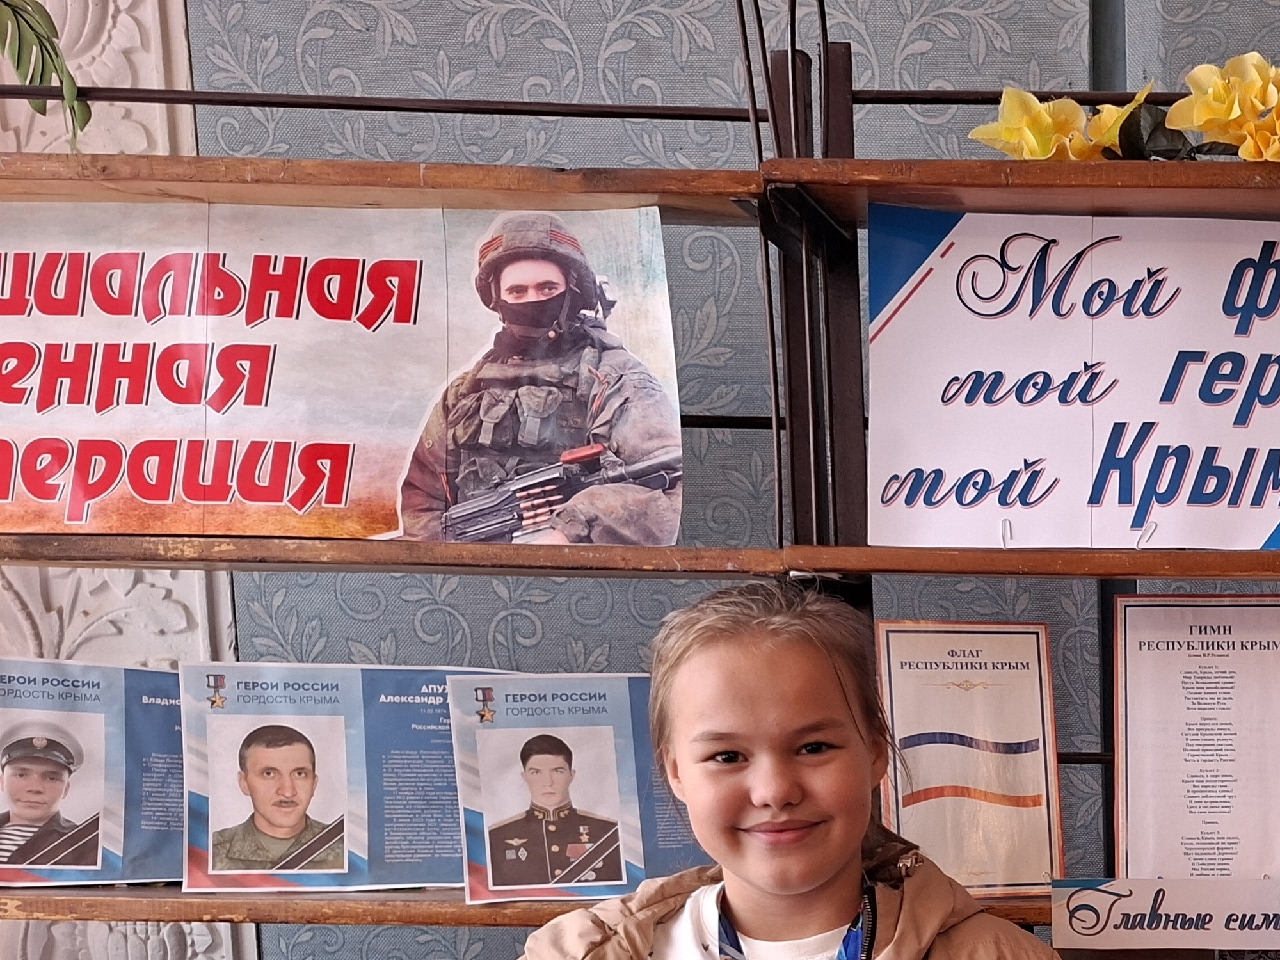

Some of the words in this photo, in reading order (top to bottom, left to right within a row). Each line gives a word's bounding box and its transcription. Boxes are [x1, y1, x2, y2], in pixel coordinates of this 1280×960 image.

[955, 232, 1181, 319] Мой
[941, 361, 1120, 406] мой
[881, 458, 1059, 508] мой
[1189, 625, 1232, 635] ГИМН
[1138, 640, 1236, 652] РЕСПУБЛИКИ
[947, 648, 983, 660] ФЛАГ
[900, 660, 989, 672] РЕСПУБЛИКИ
[992, 661, 1030, 671] КРЫМ
[41, 678, 101, 690] РОССИИ
[236, 681, 280, 692] ГЕРОИ
[285, 681, 340, 692] РОССИИ
[58, 691, 101, 702] КРЫМА
[236, 694, 297, 706] ГОРДОСТЬ
[299, 695, 340, 705] КРЫМА
[380, 694, 443, 705] Александр
[505, 693, 547, 703] ГЕРОИ
[551, 692, 607, 702] РОССИИ
[505, 706, 565, 717] ГОРДОСТЬ
[567, 706, 609, 716] КРЫМА
[1067, 888, 1213, 936] Главные
